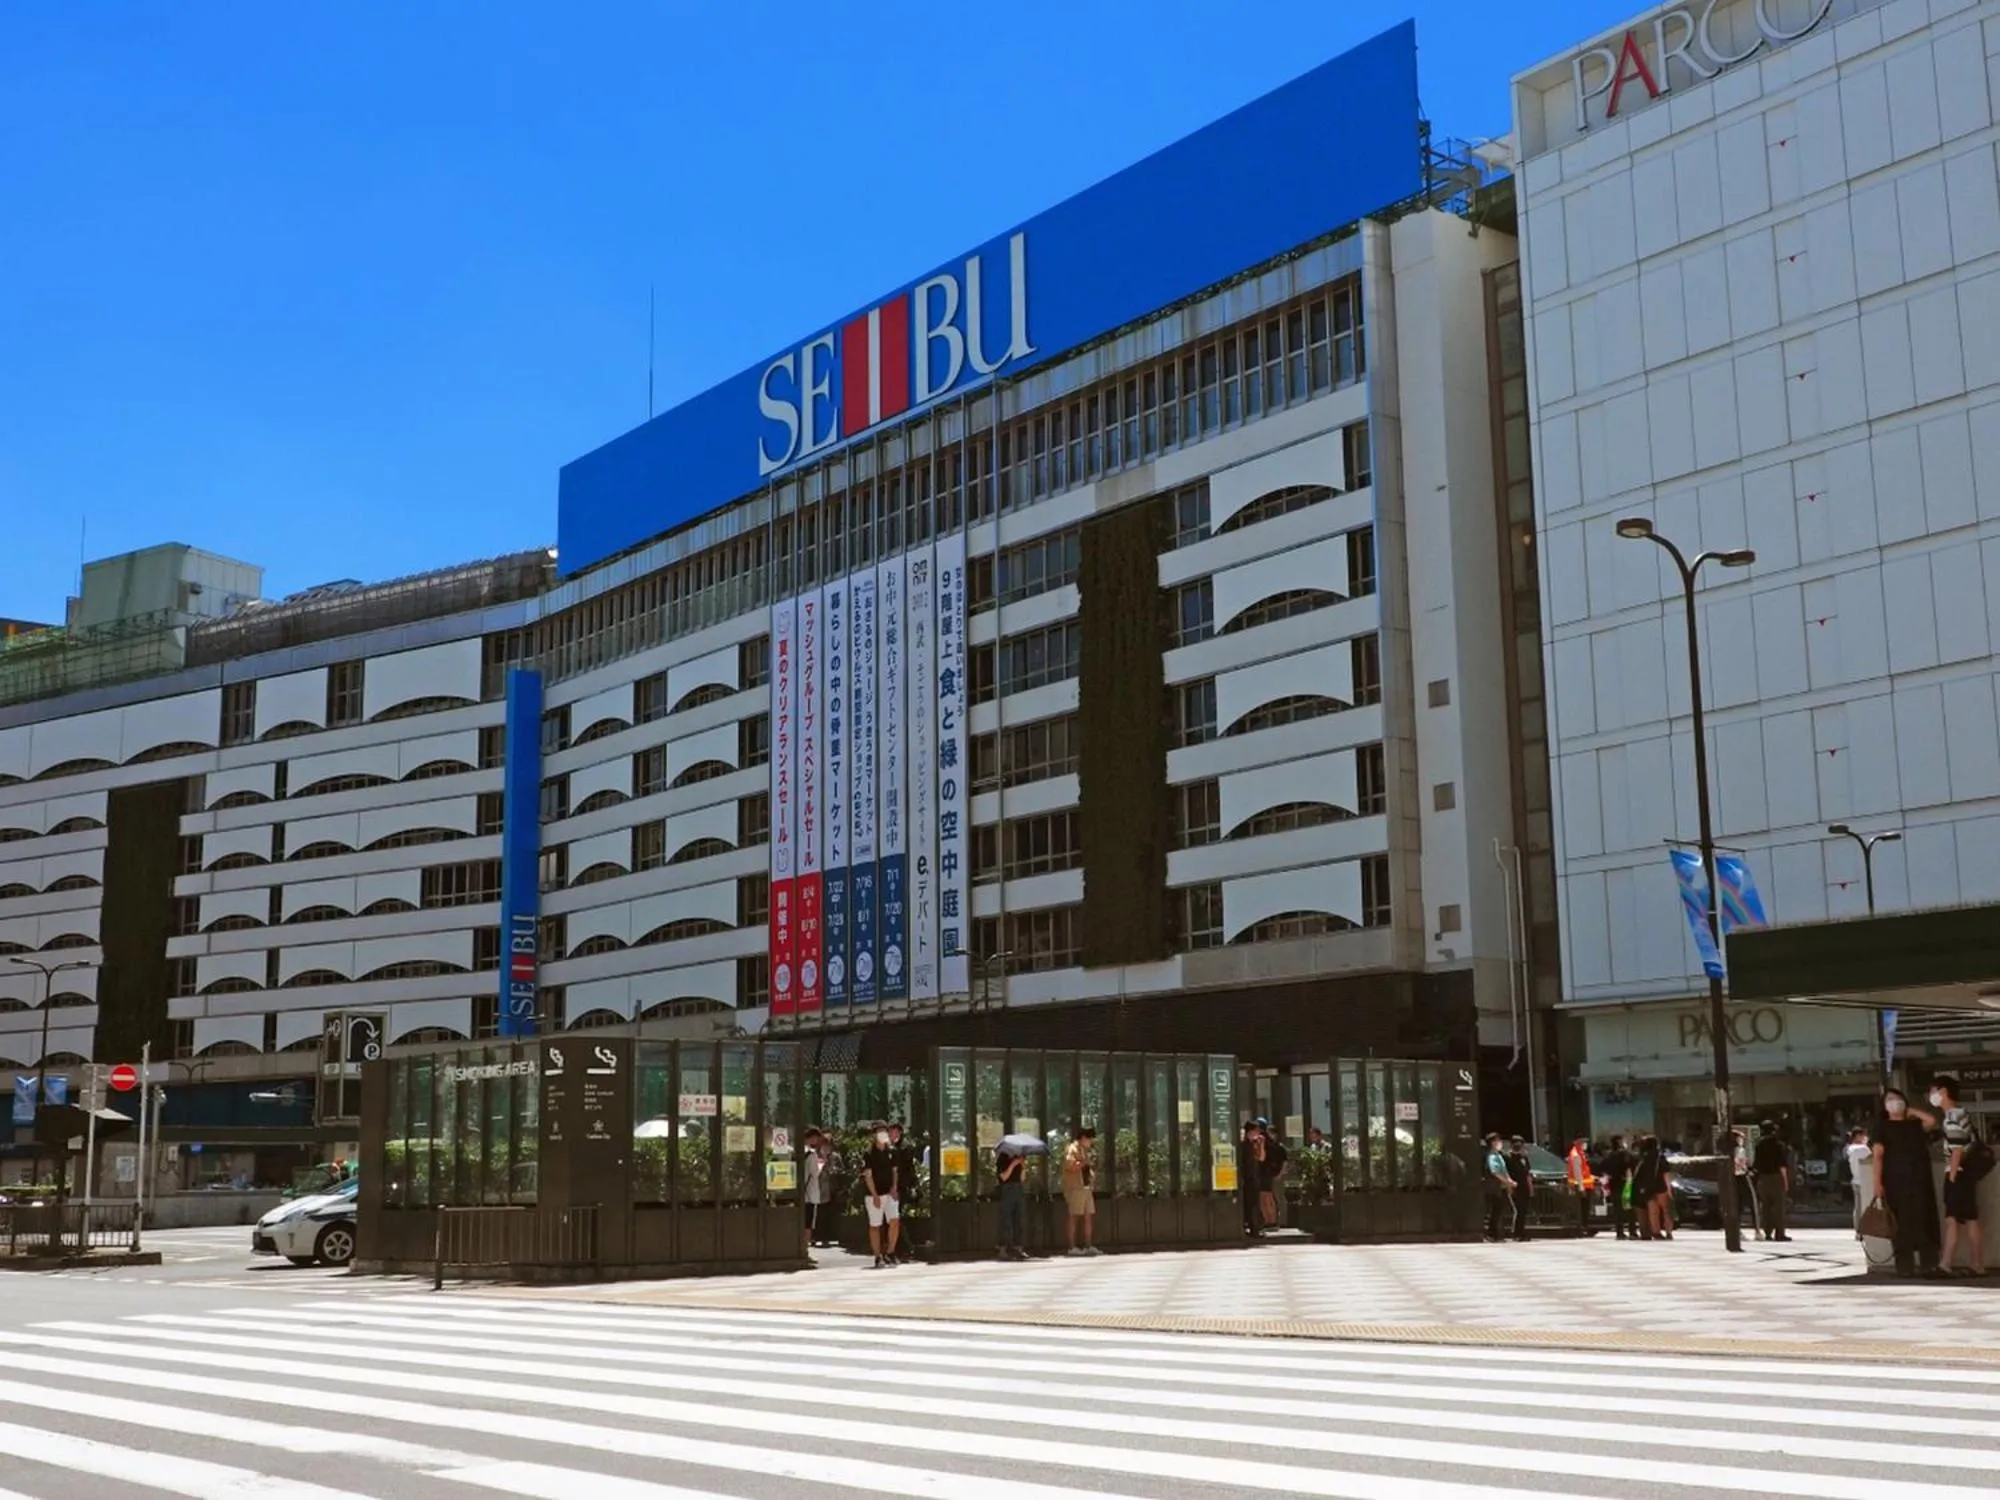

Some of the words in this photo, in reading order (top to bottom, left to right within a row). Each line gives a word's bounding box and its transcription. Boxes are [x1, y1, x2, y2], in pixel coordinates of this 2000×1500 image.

[759, 232, 1038, 476] SEIBU
[778, 639, 789, 844] 夏のクリアランスセール
[510, 914, 536, 1017] SEIBU
[777, 891, 788, 945] 開催中
[504, 1060, 536, 1076] AREA
